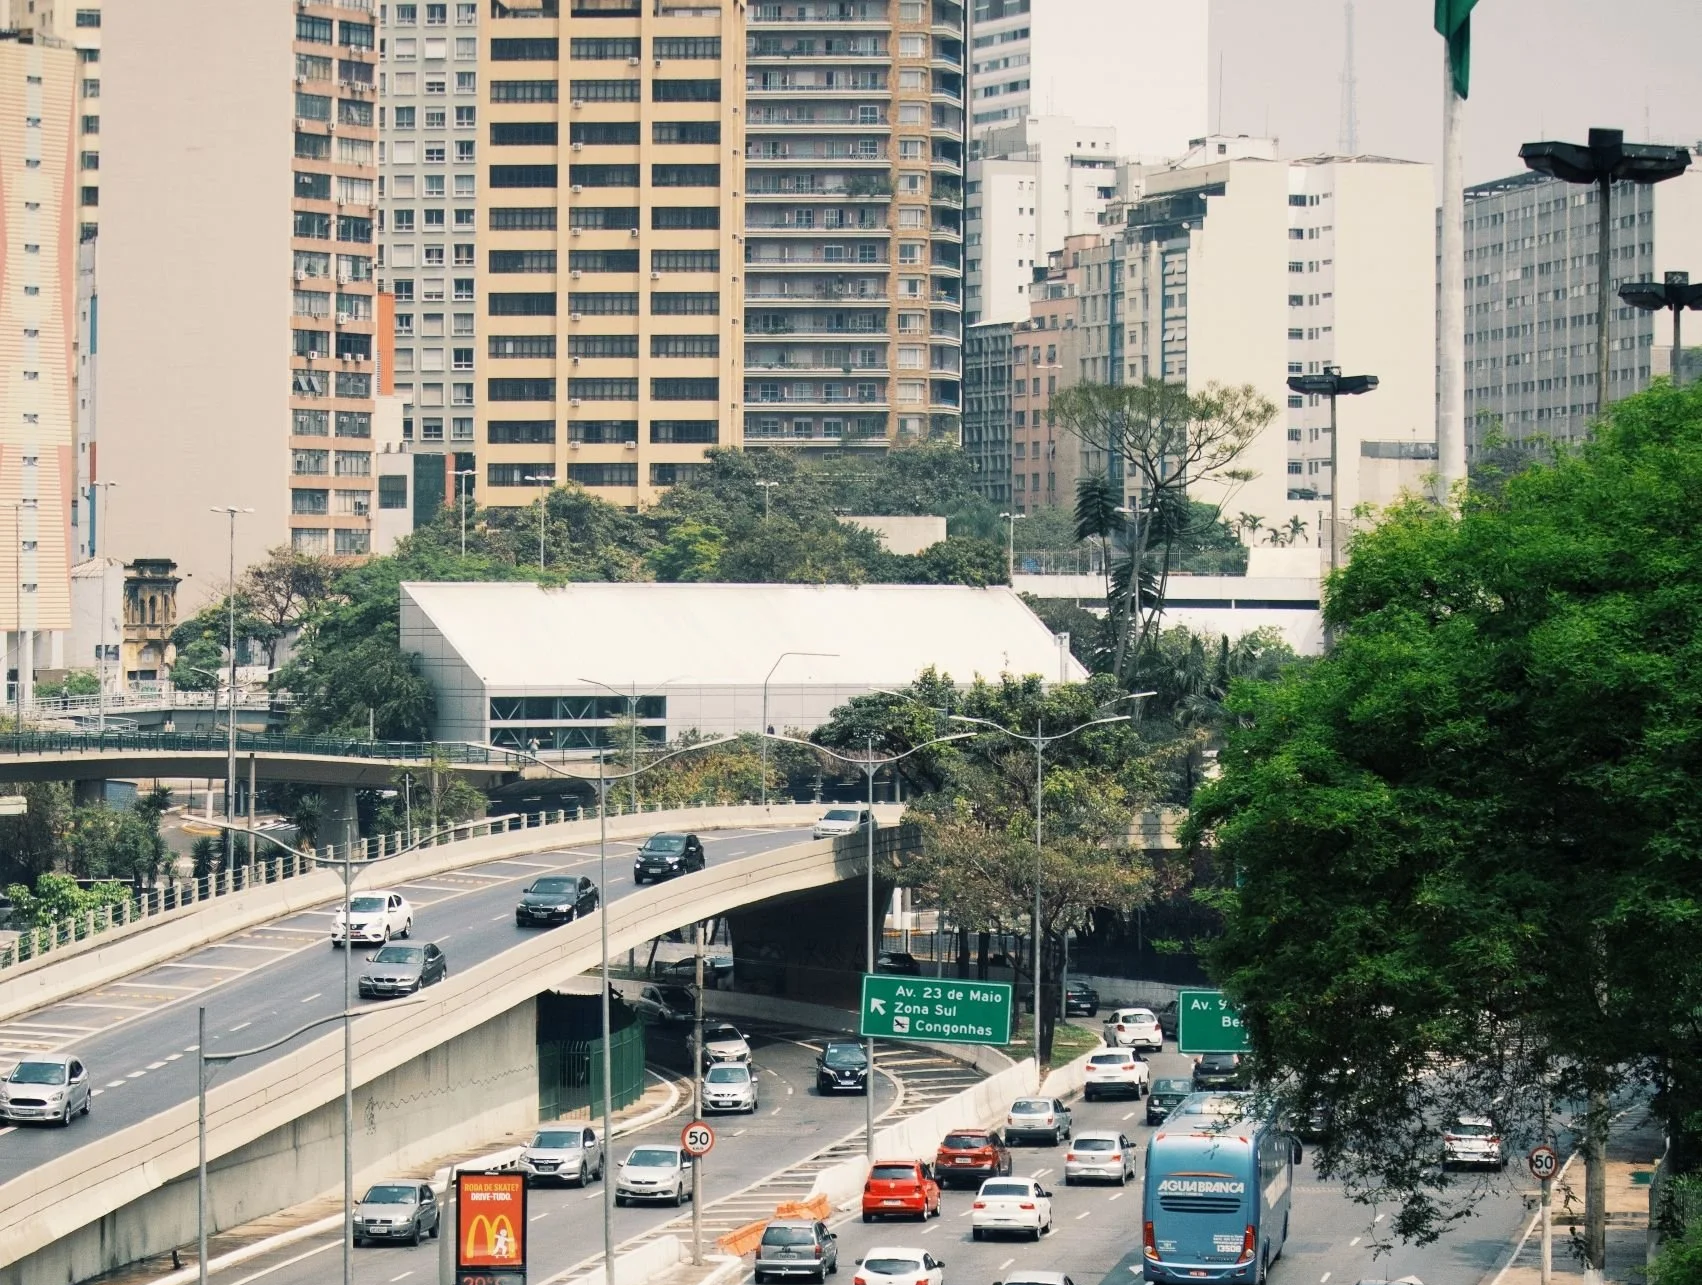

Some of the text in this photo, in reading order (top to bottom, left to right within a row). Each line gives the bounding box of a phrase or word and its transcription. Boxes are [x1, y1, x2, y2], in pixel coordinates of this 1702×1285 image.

[895, 985, 1002, 1003] Av. 23 de Maio
[893, 1002, 957, 1017] Zona Sul
[1190, 999, 1212, 1011] Av.
[915, 1020, 993, 1037] Congonhas
[688, 1131, 709, 1145] 50
[1535, 1155, 1554, 1169] 50
[464, 1183, 519, 1192] RODA DE SKATE?
